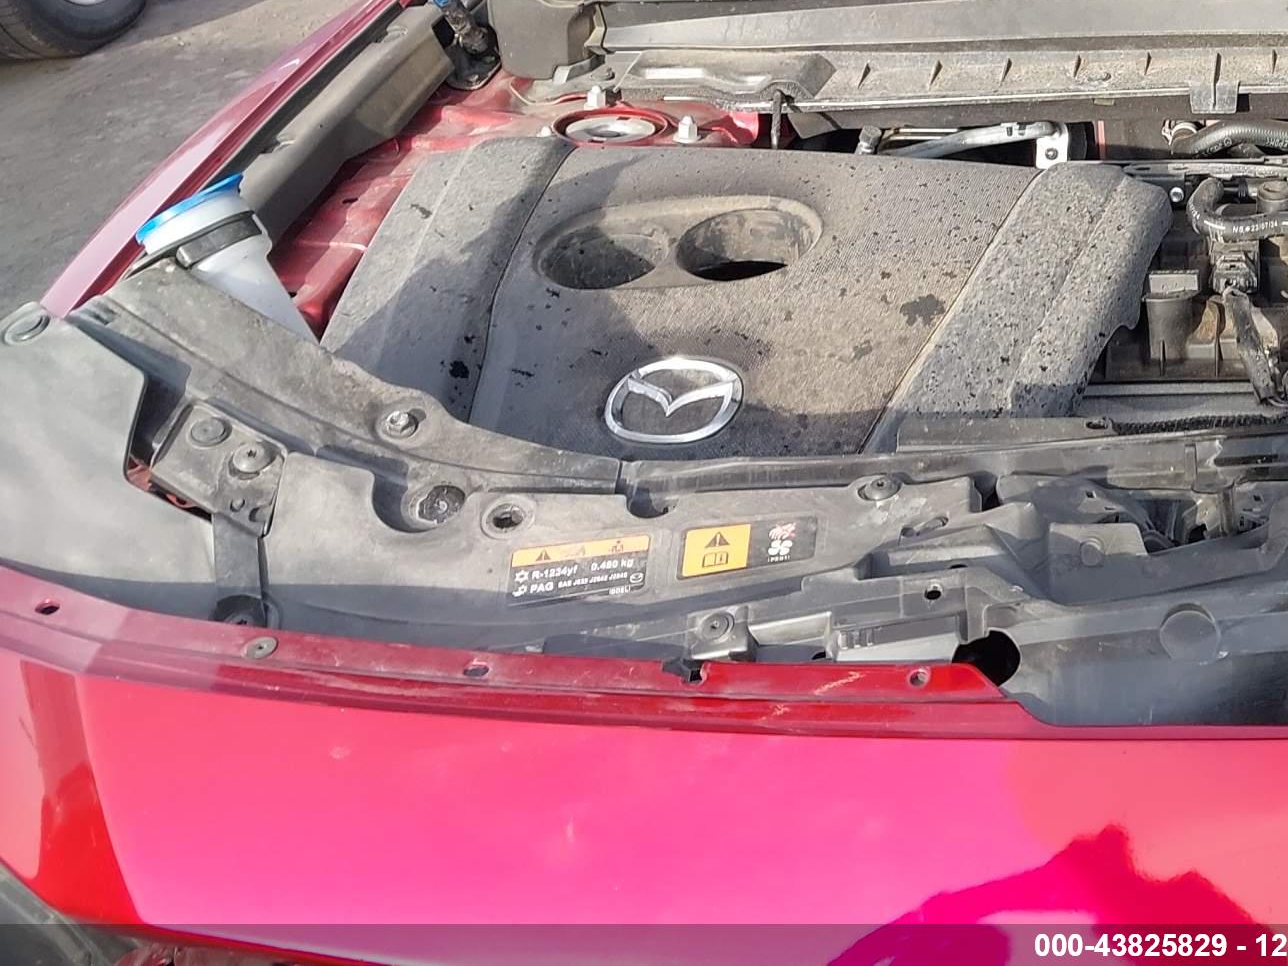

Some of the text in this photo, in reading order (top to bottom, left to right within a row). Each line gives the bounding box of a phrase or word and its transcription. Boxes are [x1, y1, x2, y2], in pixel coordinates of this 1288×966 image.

[531, 564, 578, 580] R-1234yf
[620, 558, 634, 568] kg
[529, 581, 554, 594] PAG
